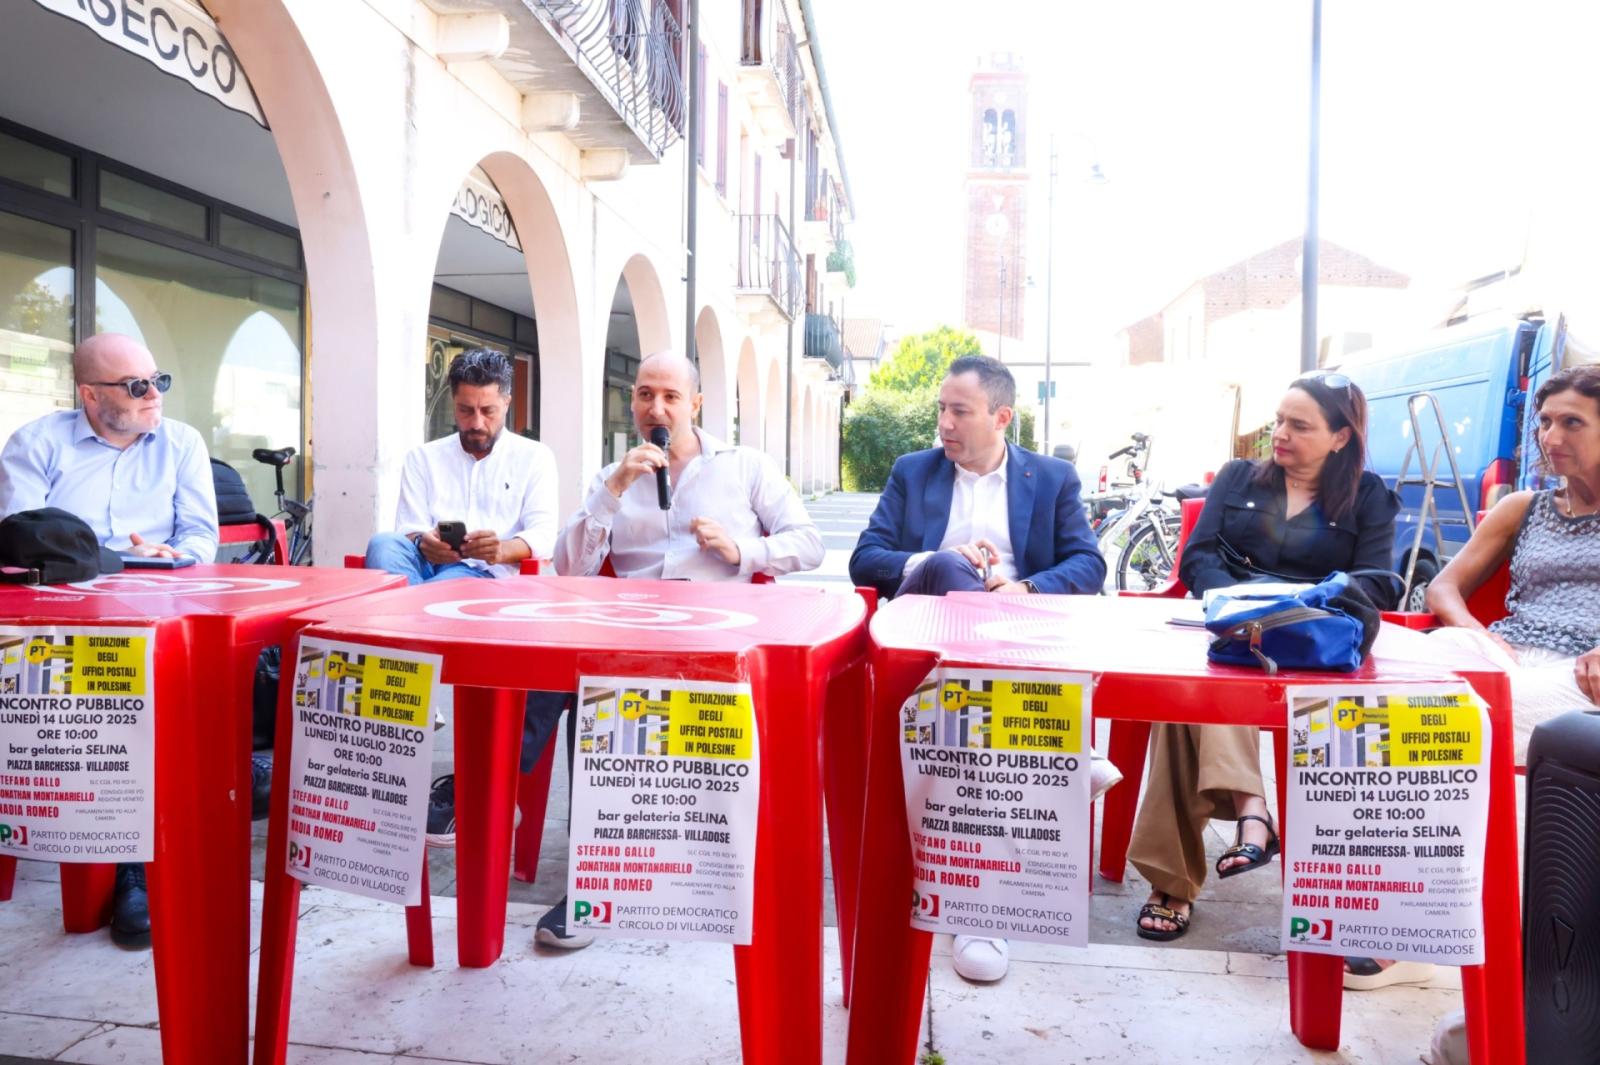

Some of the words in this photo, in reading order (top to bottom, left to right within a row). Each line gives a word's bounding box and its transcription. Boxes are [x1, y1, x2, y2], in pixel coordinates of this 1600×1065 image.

[77, 0, 236, 94] SECCO
[453, 187, 512, 238] LOGICO
[89, 637, 130, 648] SITUAZIONE
[97, 652, 118, 662] DEGLI
[82, 667, 105, 677] UFFICI
[107, 667, 136, 677] POSTALI
[379, 658, 419, 674] SITUAZIONE
[87, 681, 95, 691] IN
[97, 681, 131, 692] POLESINE
[386, 675, 405, 688] DEGLI
[1012, 683, 1063, 696] SITUAZIONE
[76, 698, 144, 711] PUBBLICO
[370, 691, 390, 703] UFFICI
[392, 693, 421, 707] POSTALI
[689, 692, 737, 706] SITUAZIONE
[1023, 699, 1048, 712] DEGLI
[1407, 696, 1459, 707] SITUAZIONE
[1, 712, 40, 724] LUNEDÌ
[43, 715, 54, 724] 14
[59, 714, 103, 725] LUGLIO
[107, 714, 137, 724] 2025
[373, 706, 380, 716] IN
[382, 708, 414, 722] POLESINE
[699, 710, 722, 722] DEGLI
[1421, 713, 1446, 726] DEGLI
[300, 710, 360, 732] INCONTRO
[365, 723, 424, 743] PUBBLICO
[1003, 718, 1031, 729] UFFICI
[1033, 718, 1070, 731] POSTALI
[38, 729, 61, 739] ORE
[65, 729, 98, 739] 10:00
[680, 725, 706, 737] UFFICI
[708, 726, 743, 739] POSTALI
[1402, 733, 1430, 743] UFFICI
[1433, 733, 1470, 743] POSTALI
[305, 725, 337, 742] LUNEDÌ
[339, 733, 349, 744] 14
[352, 735, 386, 752] LUGLIO
[390, 743, 416, 757] 2025
[685, 741, 695, 752] IN
[697, 742, 735, 755] POLESINE
[1009, 734, 1018, 745] IN
[1021, 735, 1063, 748] POLESINE
[10, 744, 28, 755] bar
[32, 745, 82, 756] gelateria
[85, 745, 127, 755] SELINA
[334, 748, 353, 761] ORE
[356, 752, 383, 766] 10:00
[1409, 750, 1419, 761] IN
[1421, 749, 1463, 761] POLESINE
[7, 760, 32, 771] PIAZZA
[86, 761, 129, 772] VILLADOSE
[911, 748, 991, 766] INCONTRO
[997, 754, 1078, 772] PUBBLICO
[308, 759, 325, 772] bar
[327, 764, 369, 781] gelateria
[373, 771, 406, 788] SELINA
[584, 758, 669, 773] INCONTRO
[673, 760, 749, 777] PUBBLICO
[919, 764, 960, 780] LUNEDÌ
[964, 769, 975, 780] 14
[979, 771, 1028, 785] LUGLIO
[1033, 774, 1069, 787] 2025
[1299, 771, 1392, 786] INCONTRO
[1397, 769, 1478, 785] PUBBLICO
[304, 774, 326, 789] PIAZZA
[372, 788, 407, 806] VILLADOSE
[590, 774, 636, 788] LUNEDÌ
[639, 777, 652, 788] 14
[655, 778, 702, 790] LUGLIO
[705, 780, 739, 792] 2025
[632, 794, 658, 805] ORE
[662, 795, 696, 806] 10:00
[957, 787, 982, 799] ORE
[986, 789, 1023, 802] 10:00
[1306, 787, 1356, 802] LUNEDÌ
[1360, 791, 1375, 802] 14
[1378, 790, 1430, 802] LUGLIO
[1434, 788, 1469, 801] 2025
[598, 810, 621, 822] bar
[624, 811, 680, 824] gelateria
[684, 812, 728, 825] SELINA
[925, 799, 946, 812] bar
[948, 804, 1006, 819] gelateria
[1010, 808, 1057, 822] SELINA
[1353, 809, 1382, 819] ORE
[1387, 808, 1425, 819] 10:00
[31, 830, 67, 840] PARTITO
[70, 831, 140, 840] DEMOCRATICO
[594, 828, 625, 839] PIAZZA
[685, 831, 730, 843] VILLADOSE
[922, 817, 950, 832] PIAZZA
[1012, 826, 1060, 841] VILLADOSE
[1316, 825, 1340, 837] bar
[1345, 826, 1408, 840] gelateria
[1413, 825, 1461, 838] SELINA
[34, 843, 71, 853] CIRCOLO
[74, 844, 83, 853] DI
[86, 845, 138, 854] VILLADOSE
[577, 845, 621, 857] STEFANO
[625, 847, 655, 858] GALLO
[1312, 844, 1345, 856] PIAZZA
[1414, 845, 1464, 857] VILLADOSE
[315, 852, 346, 868] PARTITO
[349, 860, 409, 881] DEMOCRATICO
[577, 861, 621, 872] JONATHAN
[624, 863, 692, 874] MONTANARIELLO
[1293, 862, 1342, 874] STEFANO
[1347, 863, 1381, 875] GALLO
[314, 867, 347, 883] CIRCOLO
[350, 874, 359, 885] DI
[360, 876, 406, 895] VILLADOSE
[576, 878, 610, 890] NADIA
[614, 879, 652, 891] ROMEO
[1293, 878, 1343, 890] JONATHAN
[1346, 880, 1424, 893] MONTANARIELLO
[1293, 895, 1330, 908] NADIA
[1335, 896, 1379, 910] ROMEO
[617, 906, 660, 916] PARTITO
[663, 907, 738, 920] DEMOCRATICO
[945, 900, 988, 914] PARTITO
[992, 905, 1072, 922] DEMOCRATICO
[619, 920, 663, 930] CIRCOLO
[666, 921, 677, 931] DI
[680, 922, 735, 934] VILLADOSE
[947, 915, 994, 929] CIRCOLO
[996, 919, 1008, 930] DI
[1010, 921, 1069, 936] VILLADOSE
[1339, 924, 1387, 936] PARTITO
[1391, 926, 1476, 938] DEMOCRATICO
[1340, 939, 1393, 950] CIRCOLO
[1397, 941, 1409, 951] DI
[1412, 942, 1475, 954] VILLADOSE
